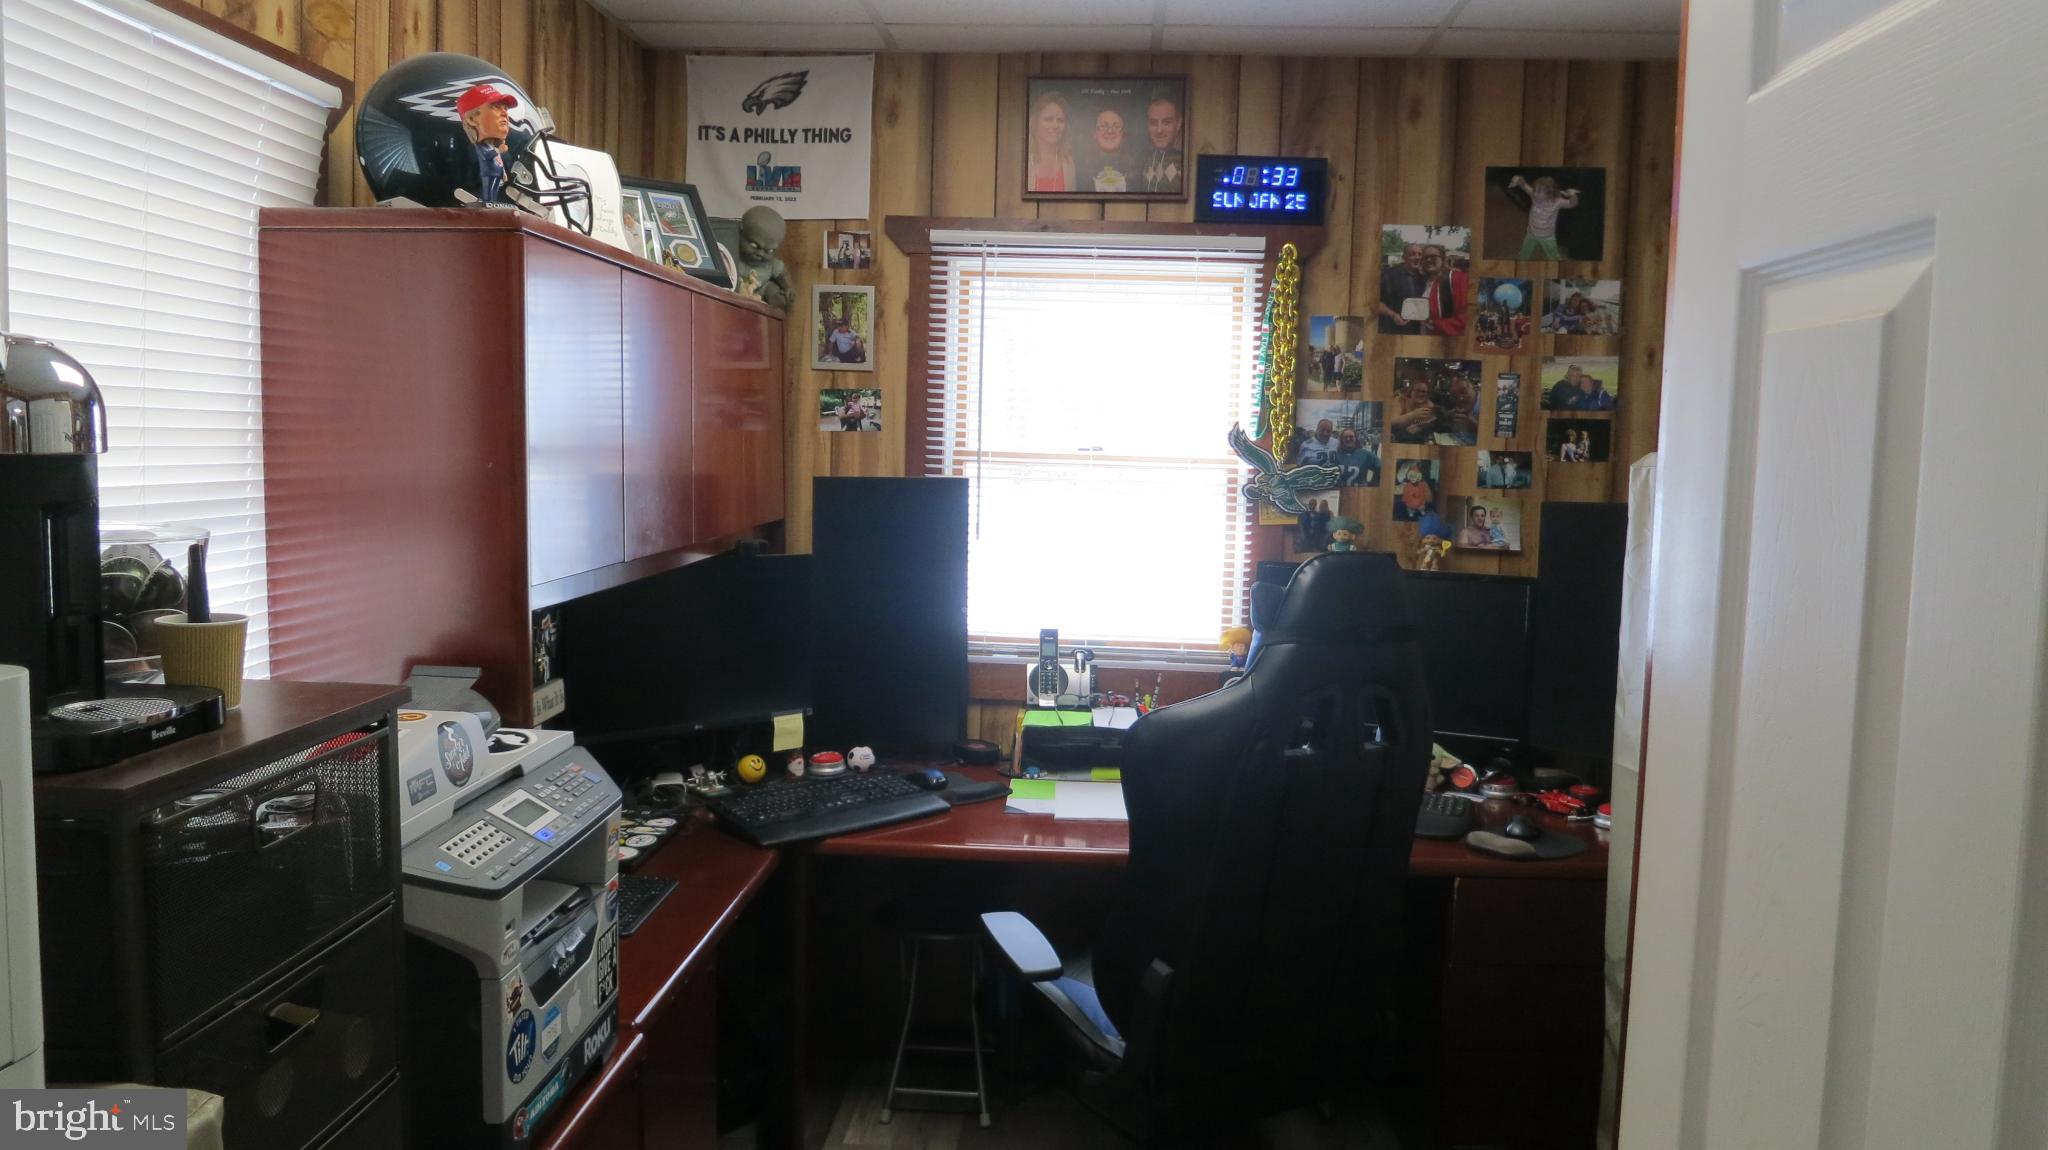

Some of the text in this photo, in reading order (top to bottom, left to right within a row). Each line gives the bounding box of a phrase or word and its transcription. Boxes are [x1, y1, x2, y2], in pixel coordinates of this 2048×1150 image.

[698, 125, 852, 144] IT'S A PHILLY THING
